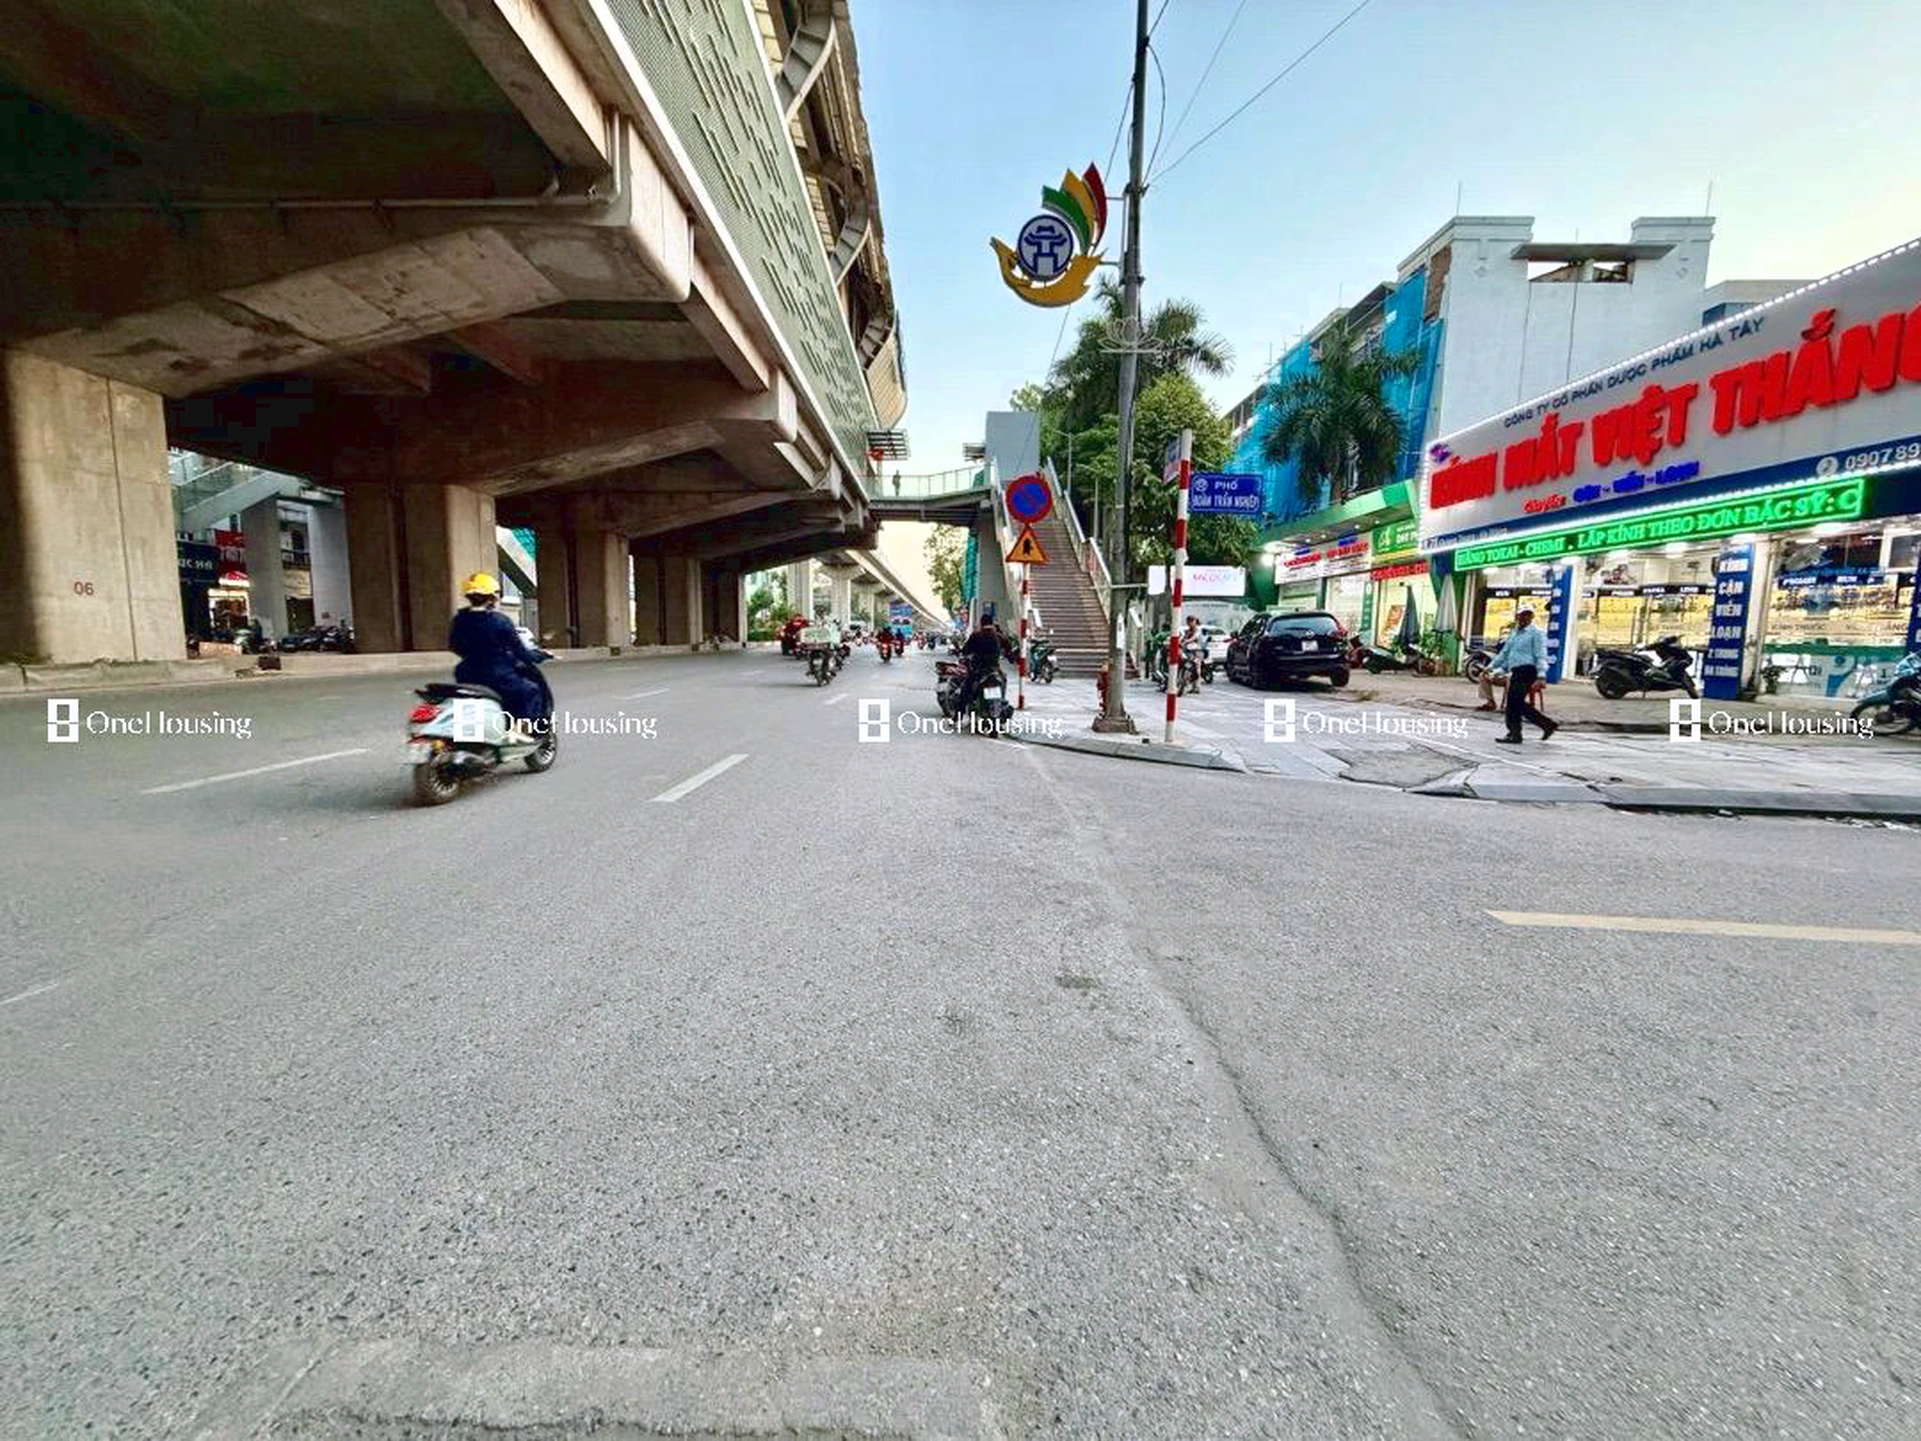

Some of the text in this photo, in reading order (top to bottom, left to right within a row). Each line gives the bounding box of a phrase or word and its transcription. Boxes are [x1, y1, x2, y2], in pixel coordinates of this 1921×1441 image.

[1537, 401, 1550, 414] TY
[1592, 383, 1699, 467] VIỆT
[1214, 478, 1239, 491] PHỐ
[1648, 515, 1695, 537] THEO
[1743, 497, 1792, 524] BÁC
[74, 581, 94, 596] 06
